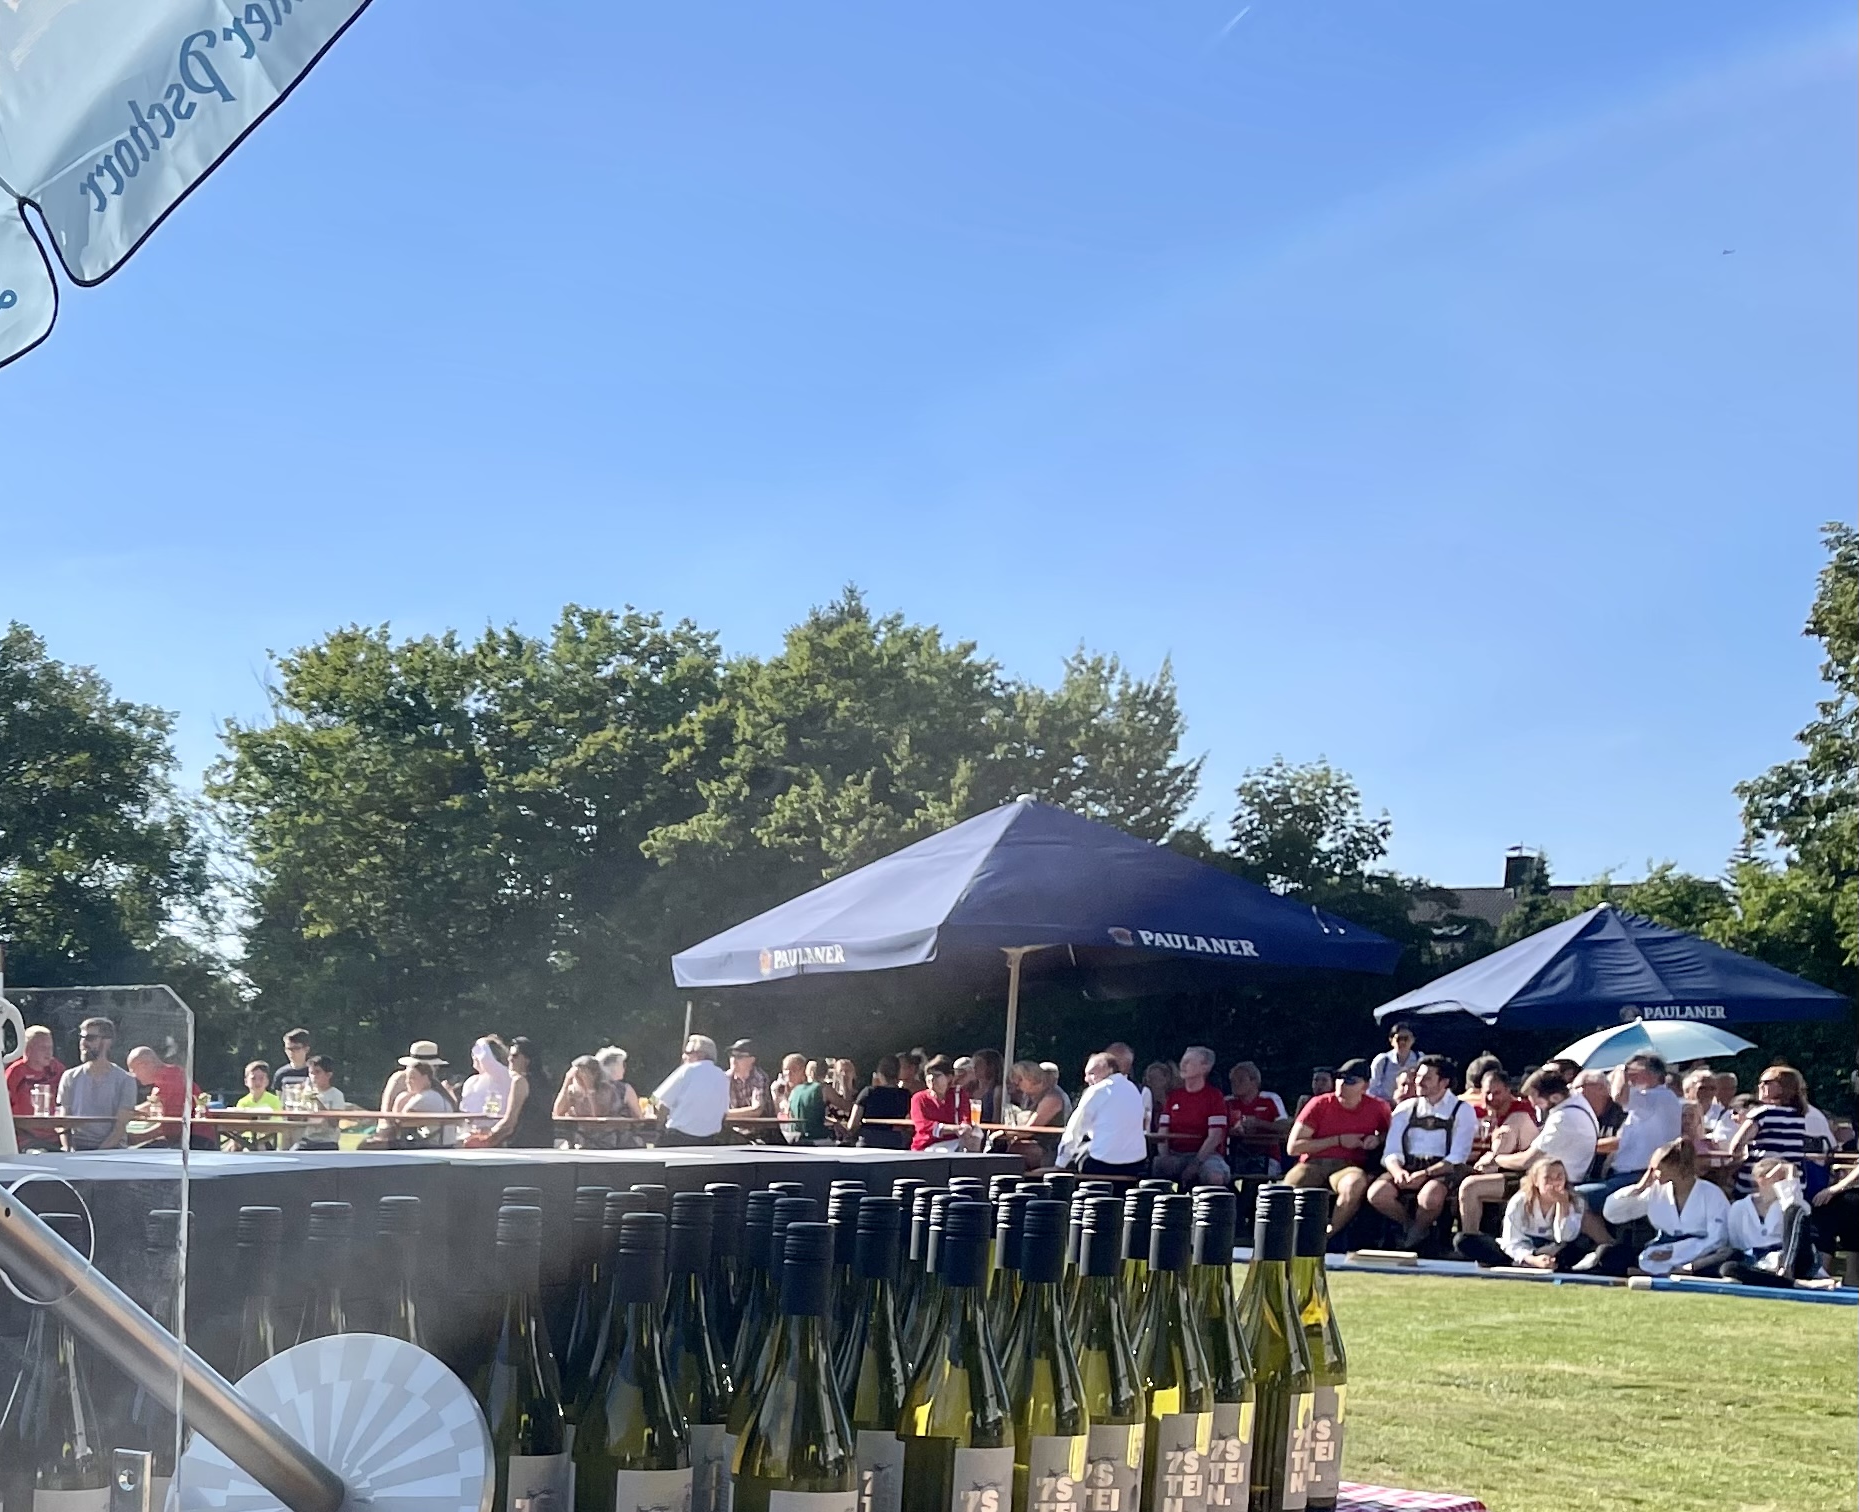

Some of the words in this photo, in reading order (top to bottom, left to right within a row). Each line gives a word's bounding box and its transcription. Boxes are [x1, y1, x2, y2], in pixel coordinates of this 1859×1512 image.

[1137, 928, 1260, 957] PAULANER
[773, 943, 846, 970] PAULANER
[1643, 1005, 1728, 1020] PAULANER
